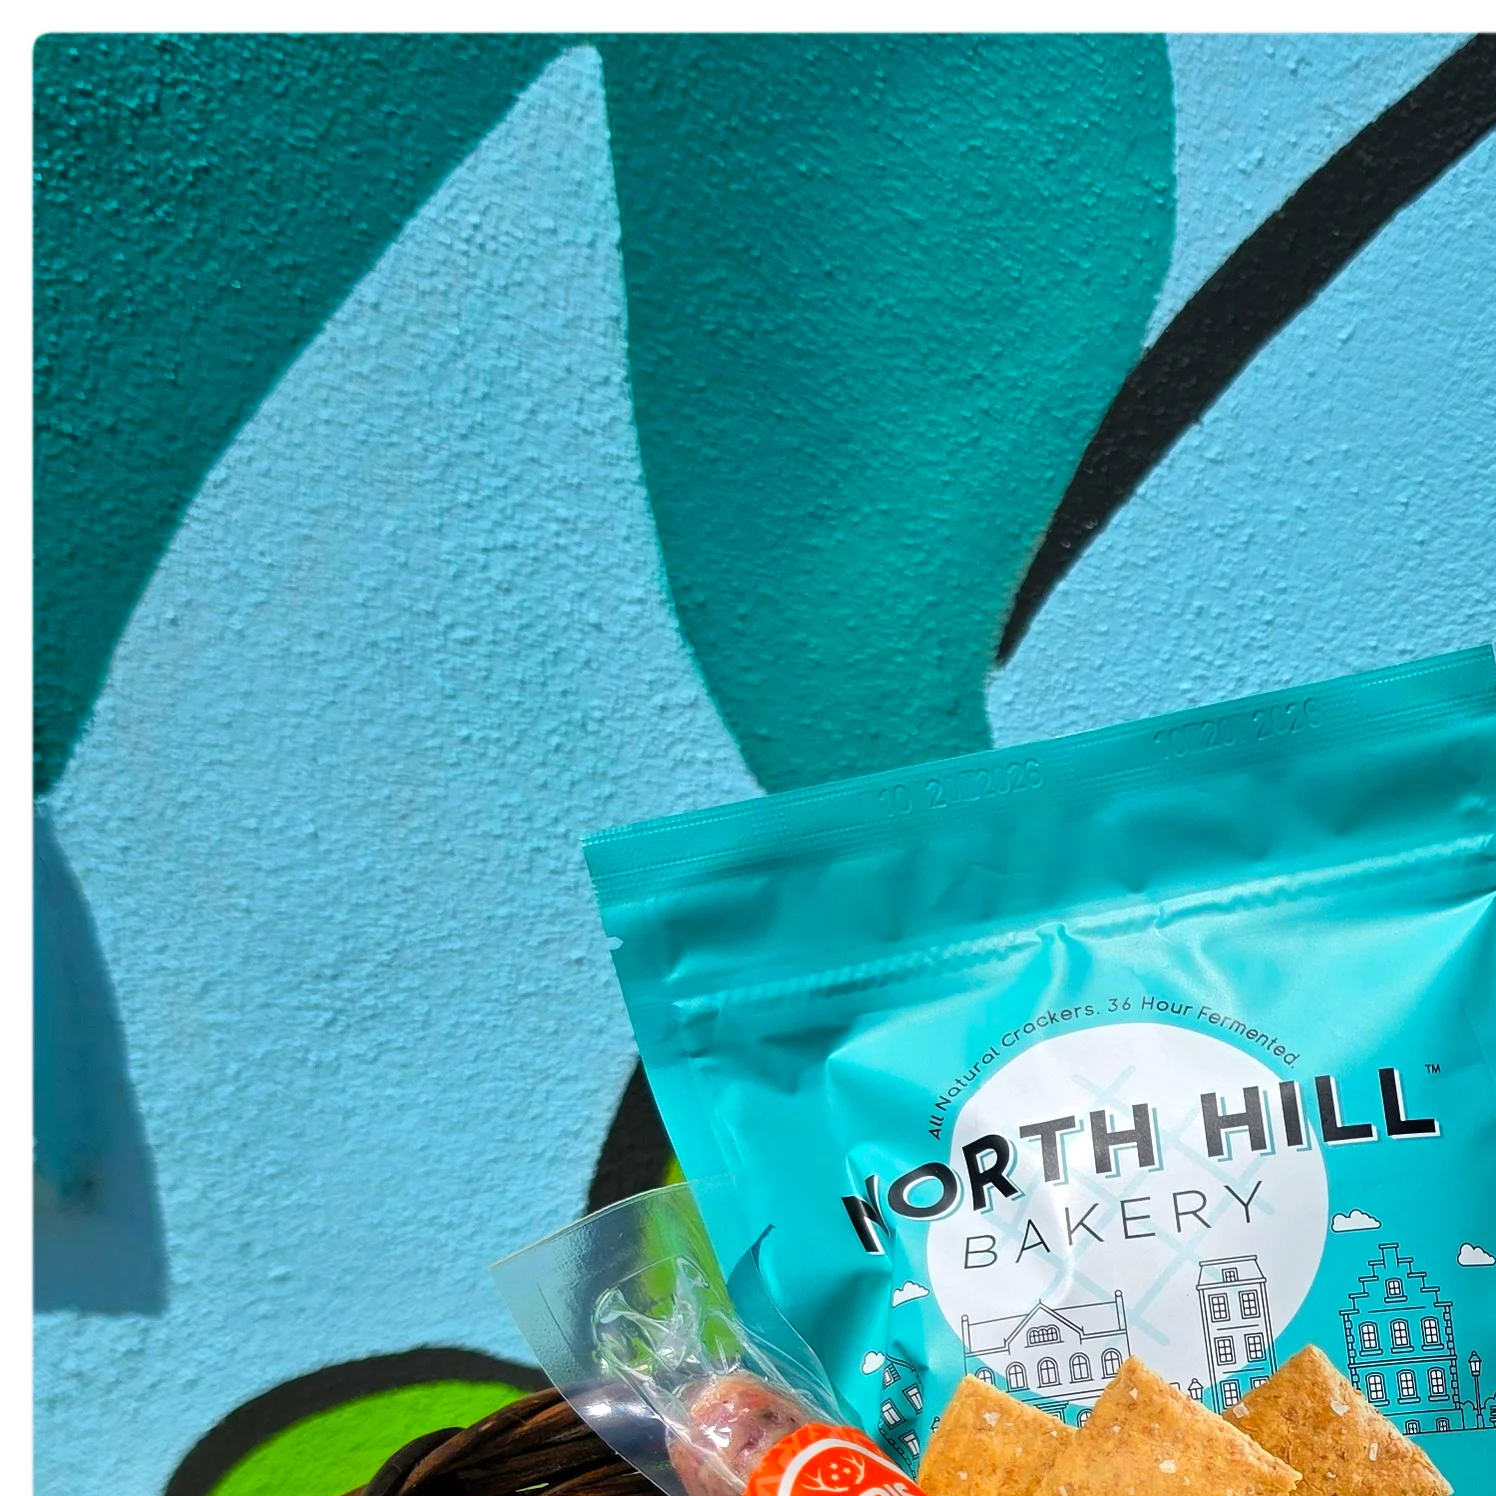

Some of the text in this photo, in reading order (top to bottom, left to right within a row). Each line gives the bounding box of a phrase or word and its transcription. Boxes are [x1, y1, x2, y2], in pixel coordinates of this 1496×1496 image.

[928, 995, 1302, 1142] All Natural Crackers. 36 Hour Fermented.
[840, 1102, 1164, 1256] NORTH
[1200, 1066, 1442, 1161] HILL
[963, 1179, 1264, 1271] BAKERY
